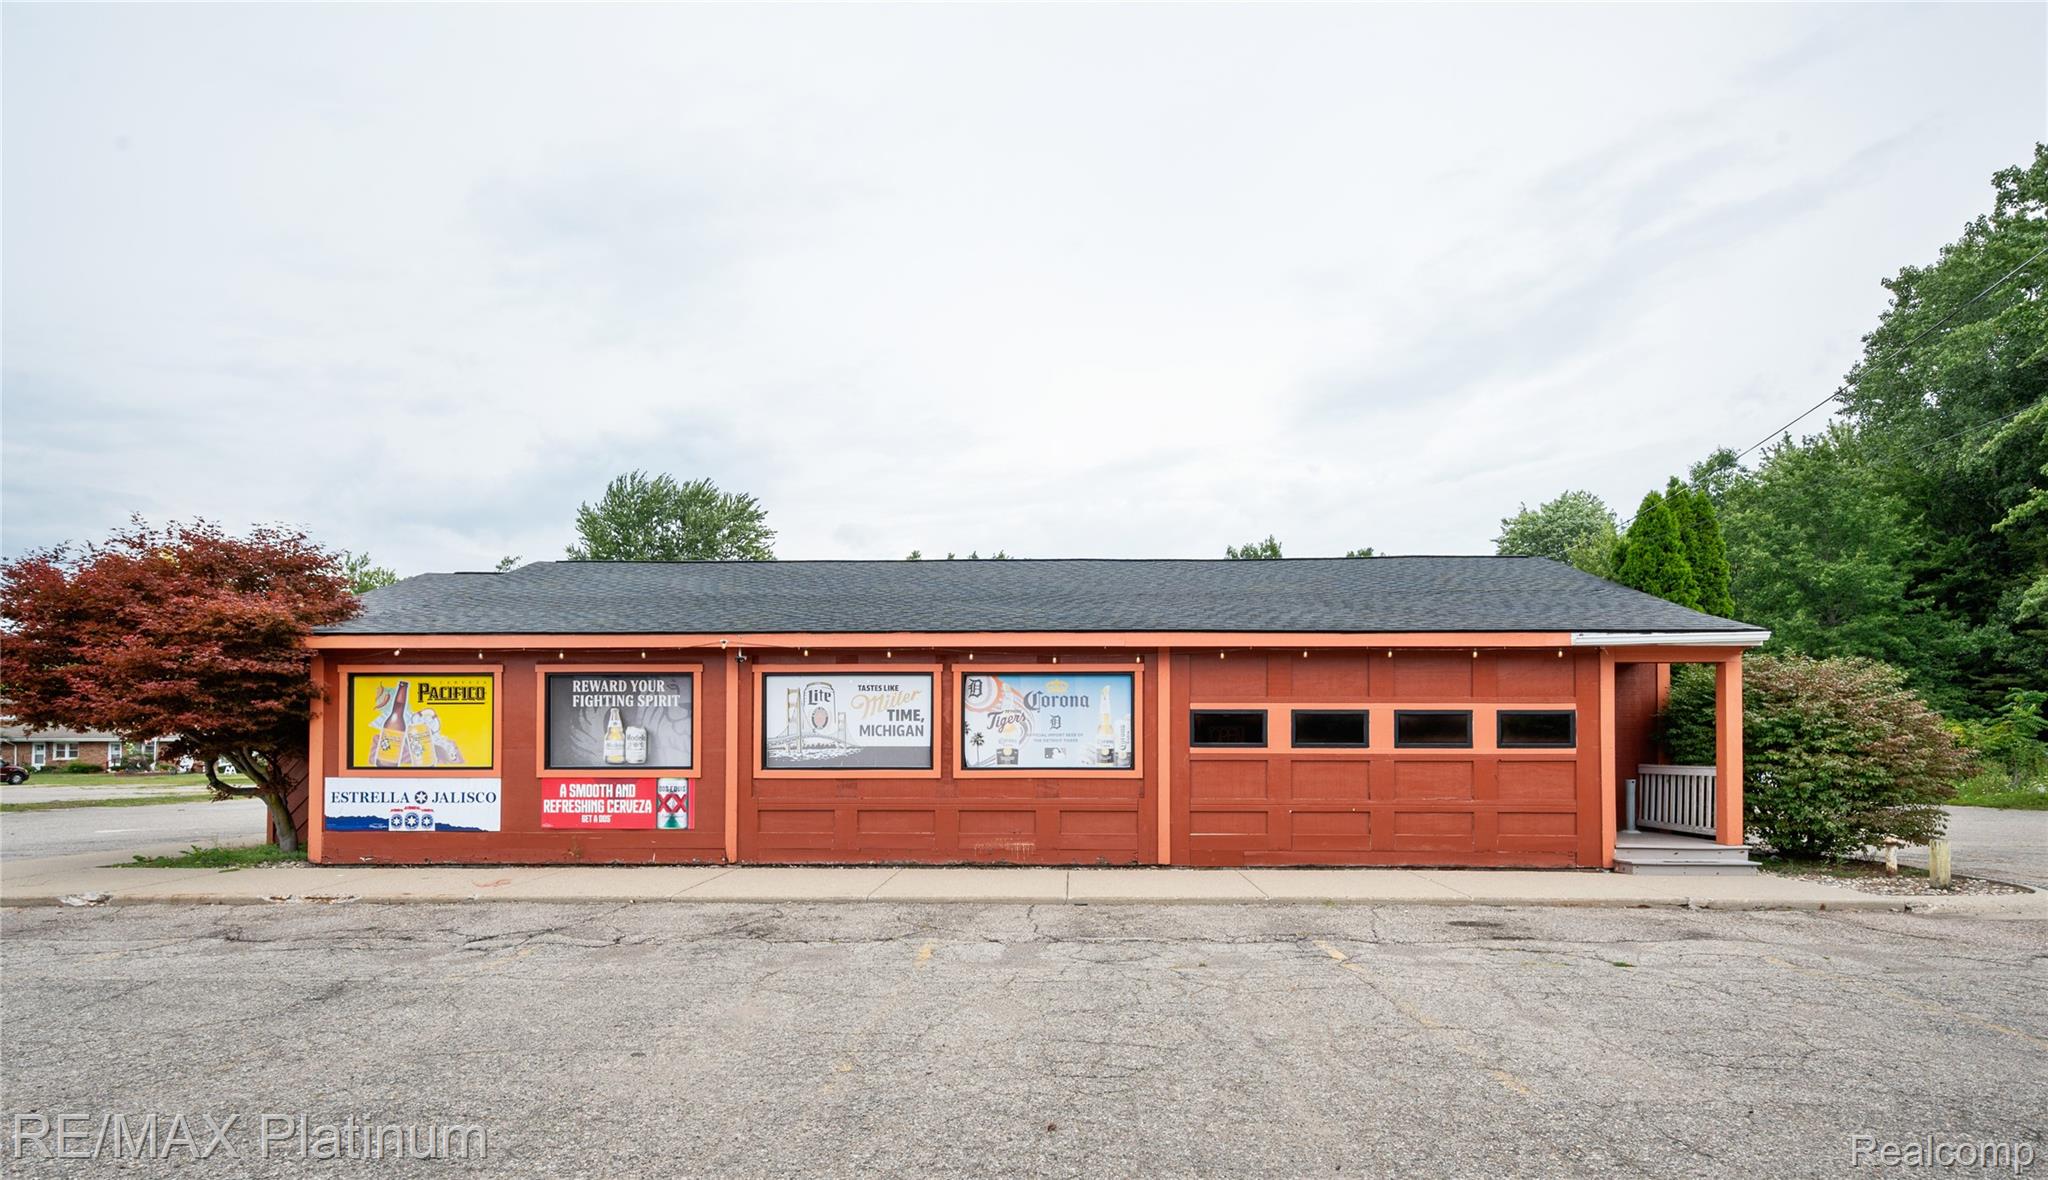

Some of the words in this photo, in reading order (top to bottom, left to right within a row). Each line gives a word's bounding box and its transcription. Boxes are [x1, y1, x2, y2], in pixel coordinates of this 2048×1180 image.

[572, 680, 627, 692] REWARD
[630, 680, 665, 692] YOUR
[572, 695, 634, 707] FIGHTING
[637, 695, 680, 707] SPIRIT
[808, 689, 831, 705] Lite
[1023, 690, 1089, 713] Corona
[850, 690, 921, 719] Miller
[887, 709, 925, 723] TIME,
[986, 711, 1026, 733] Tigers
[859, 725, 924, 737] MICHIGAN
[331, 791, 410, 804] ESTRELLA
[431, 791, 497, 804] JALISCO
[559, 784, 567, 798] A
[569, 784, 613, 798] SMOOTH
[615, 784, 636, 798] AND
[543, 799, 606, 813] REFRESHING
[607, 799, 652, 813] CERVEZA
